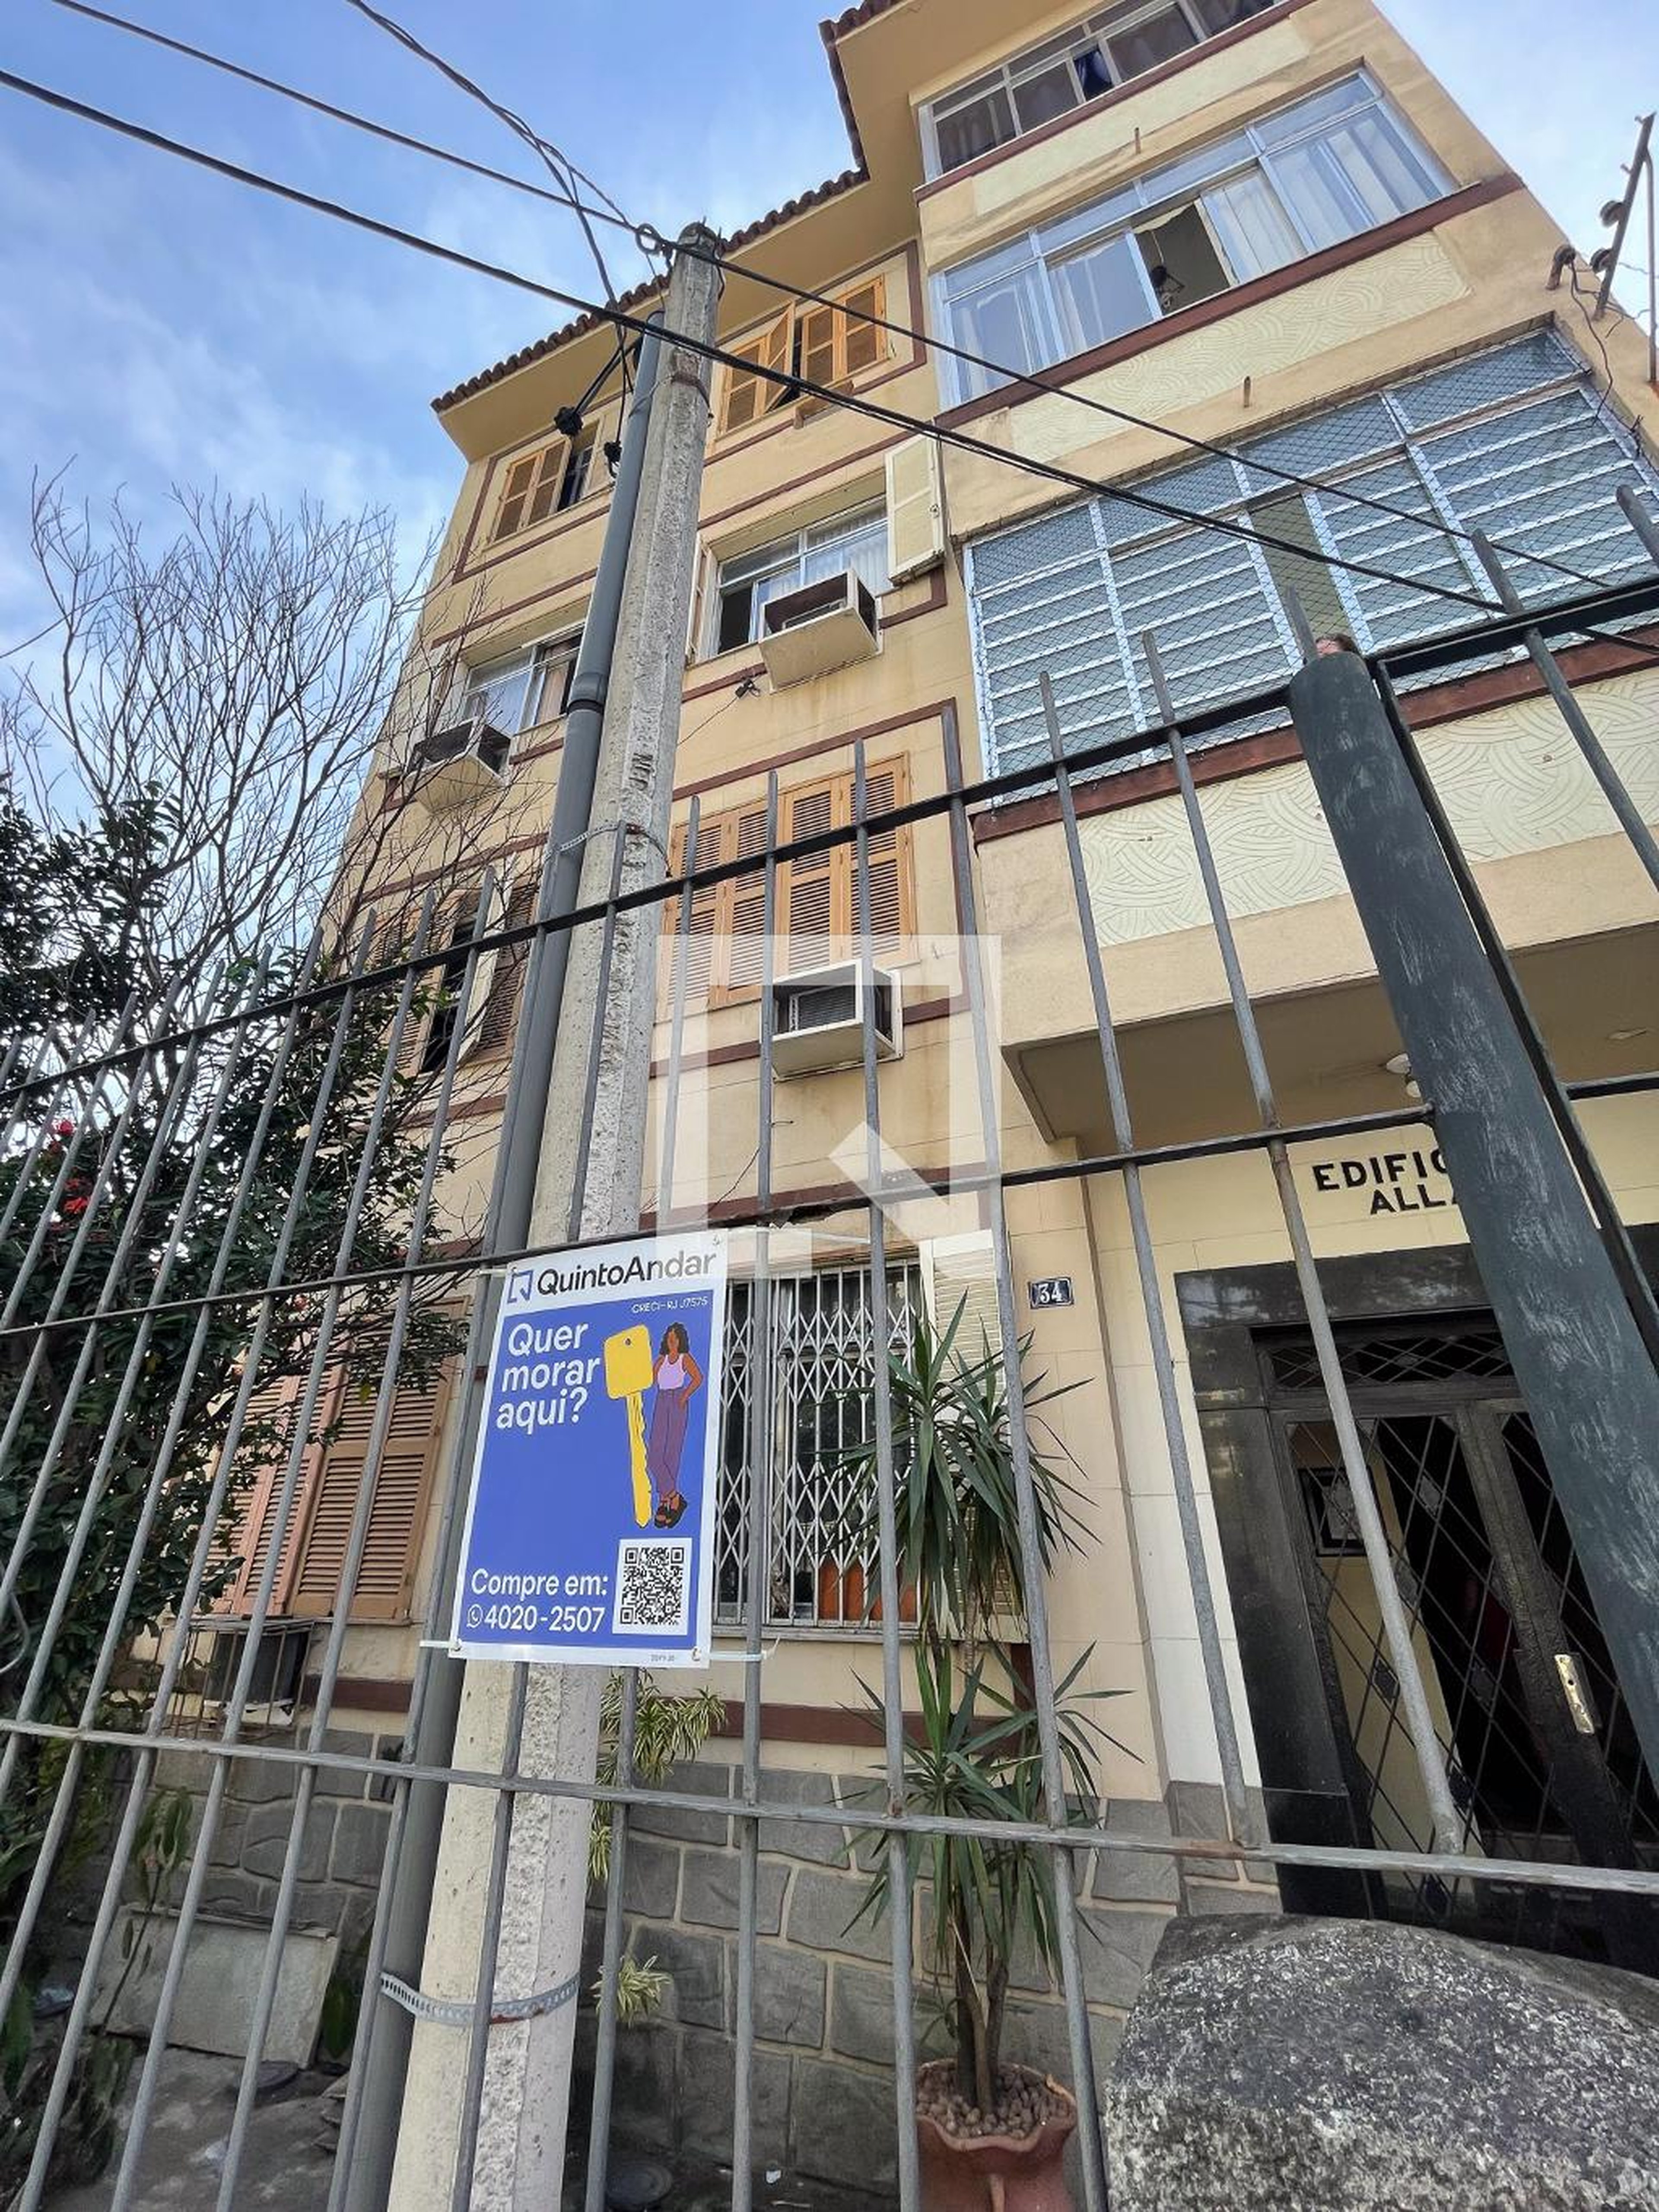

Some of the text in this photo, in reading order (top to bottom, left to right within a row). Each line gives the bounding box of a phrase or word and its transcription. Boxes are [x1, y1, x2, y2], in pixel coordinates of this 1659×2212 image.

[1370, 1184, 1457, 1215] ALL
[537, 1251, 716, 1295] QuintoAndar
[1038, 1281, 1063, 1303] 34
[508, 1322, 588, 1357] Quer
[501, 1358, 600, 1392] morar
[496, 1386, 588, 1434] aqui?
[471, 1568, 608, 1601] Compre em:
[484, 1605, 605, 1633] 4020-2507
